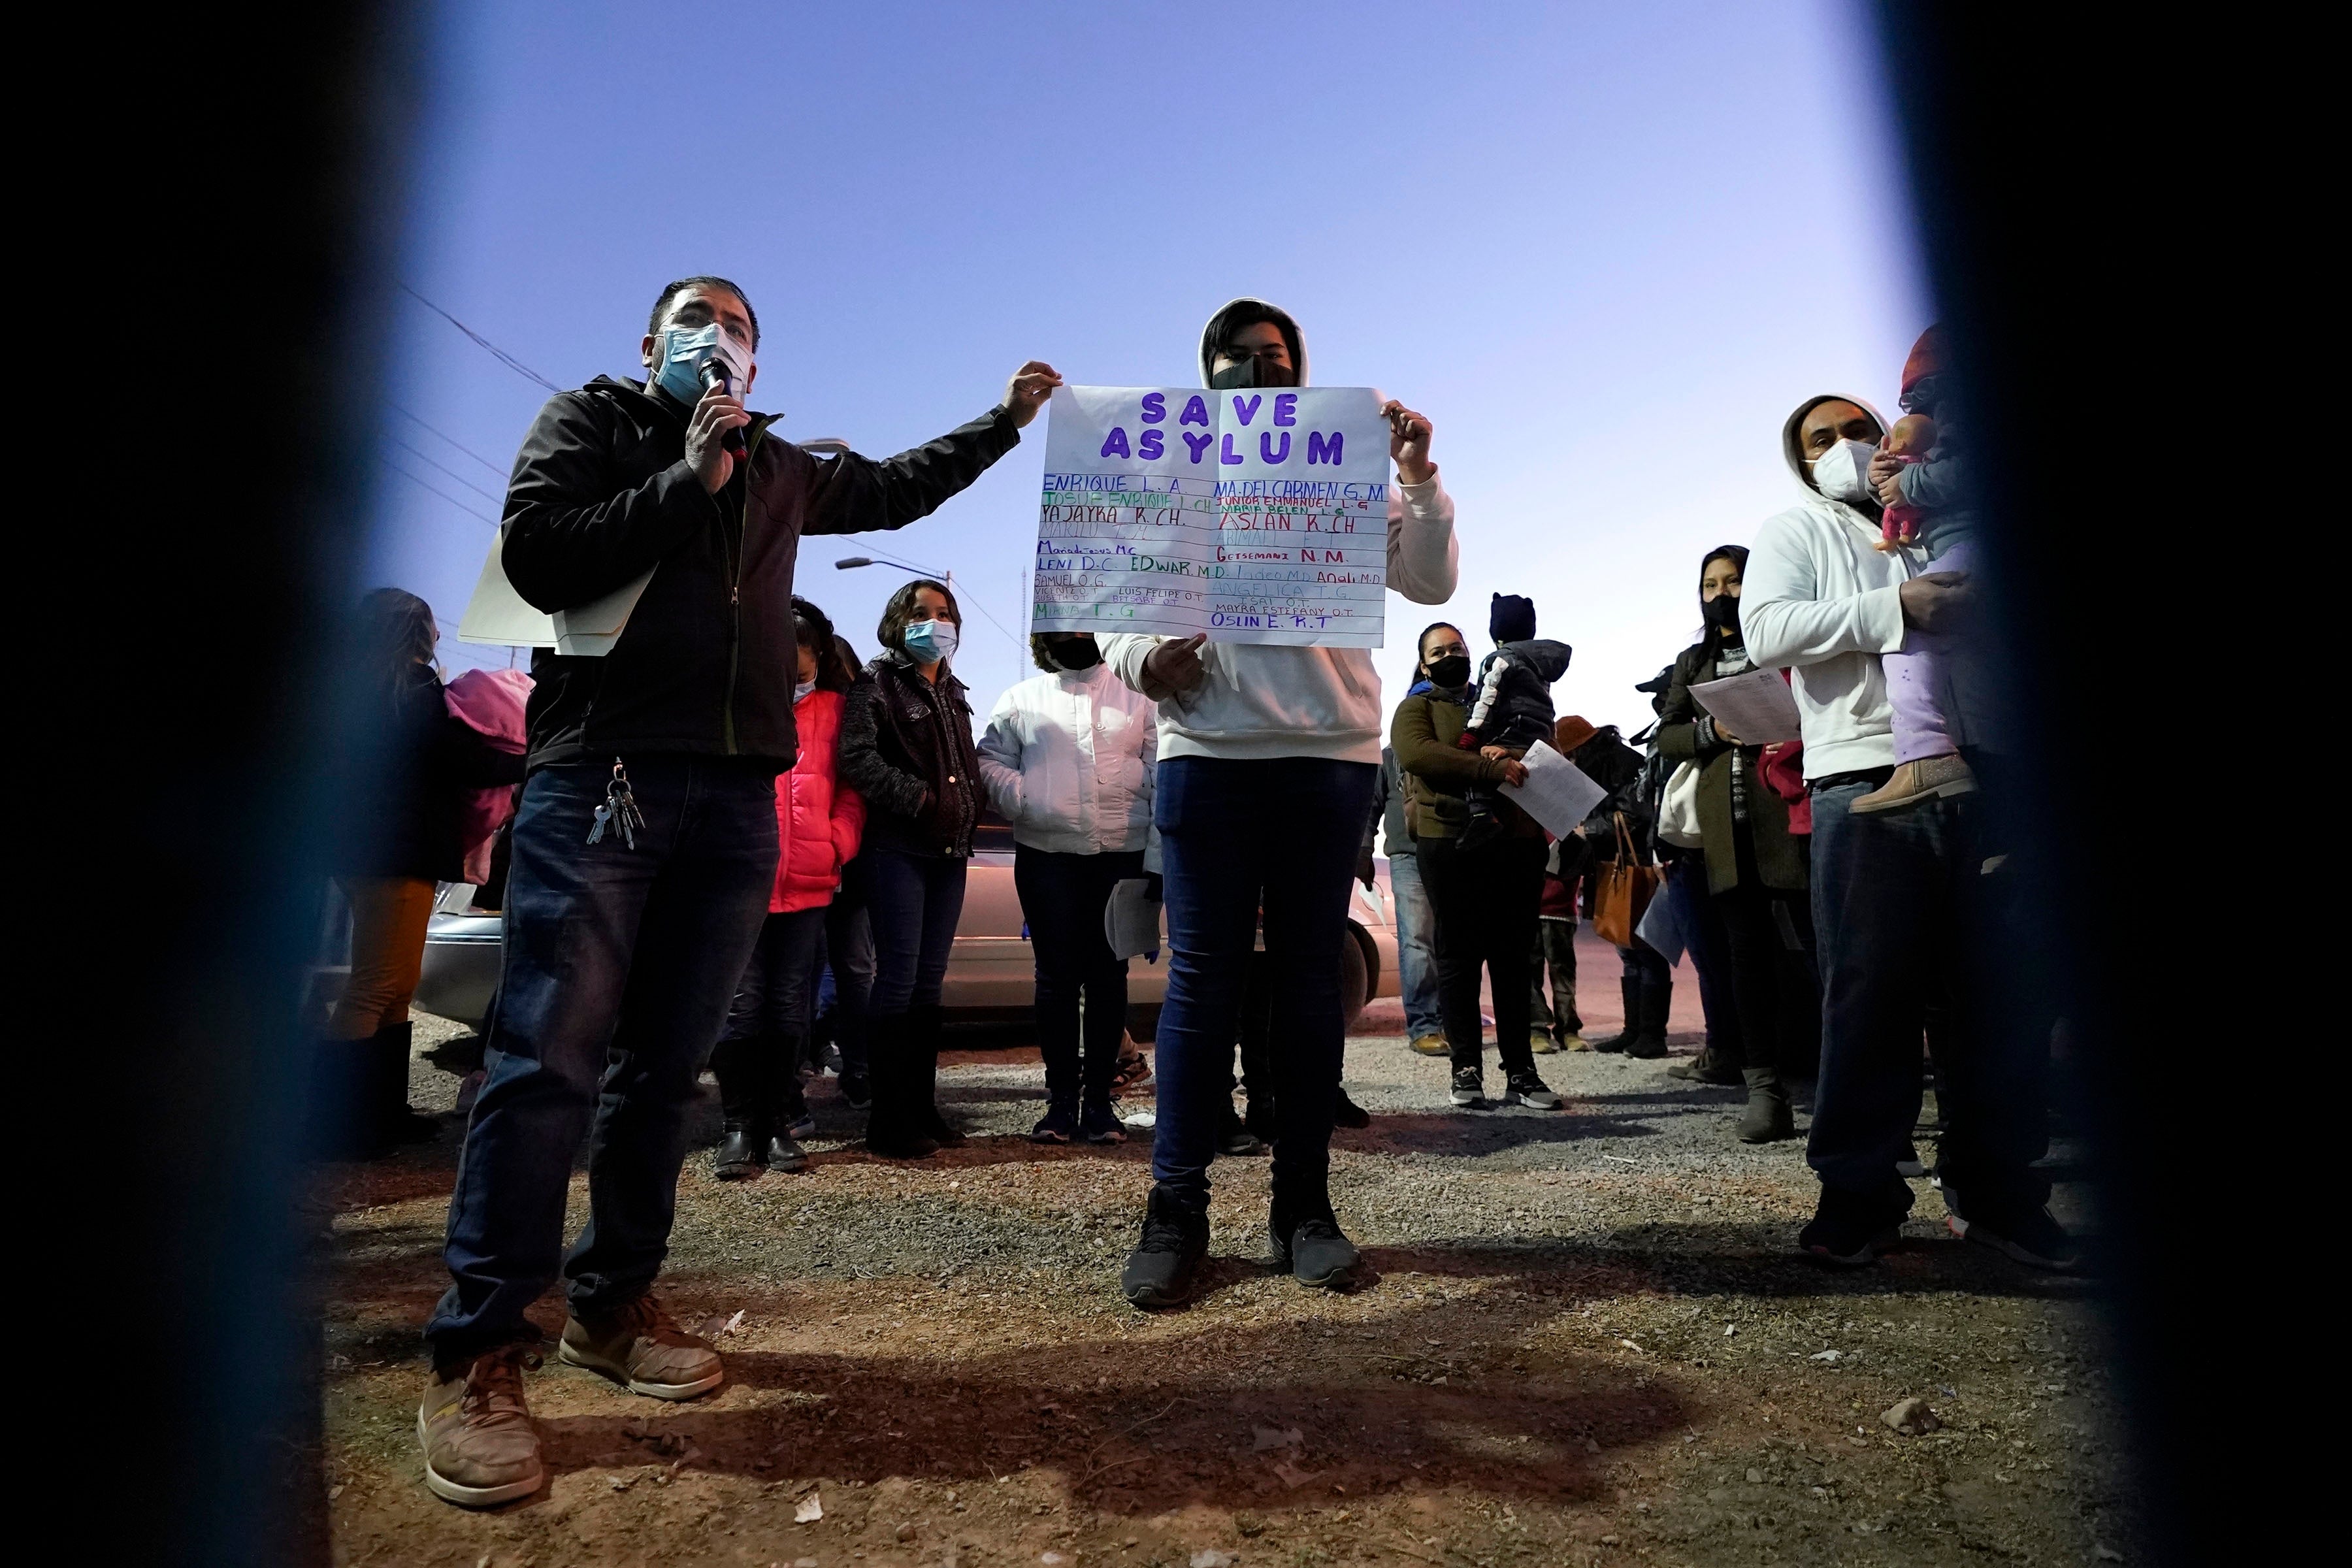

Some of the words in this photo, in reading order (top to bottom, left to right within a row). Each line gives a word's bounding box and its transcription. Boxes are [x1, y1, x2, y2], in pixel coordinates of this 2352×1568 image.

[1141, 393, 1298, 427] SAVE
[1101, 427, 1343, 465] ASYLUM
[1044, 474, 1128, 491] ENRIQUE
[1272, 480, 1338, 499] CARMEN
[1367, 484, 1383, 501] M
[1108, 492, 1172, 508] ENRIQUE
[1216, 496, 1260, 506] JUNIOR
[1264, 497, 1331, 508] EMMANUEL
[1043, 505, 1117, 523] YAJAYRA
[1221, 505, 1262, 514] MARIA
[1267, 505, 1308, 515] BELEN
[1219, 512, 1290, 531] ASLAN
[1333, 516, 1354, 533] CH
[1038, 558, 1071, 570] LENI
[1035, 574, 1074, 587] SAMUEL
[1213, 580, 1305, 597] ANGELICA
[1146, 589, 1180, 598] FELIPE
[1216, 604, 1256, 613] MAYRA
[1263, 606, 1324, 615] ESTEFANY
[1211, 613, 1260, 627] OSLIN
